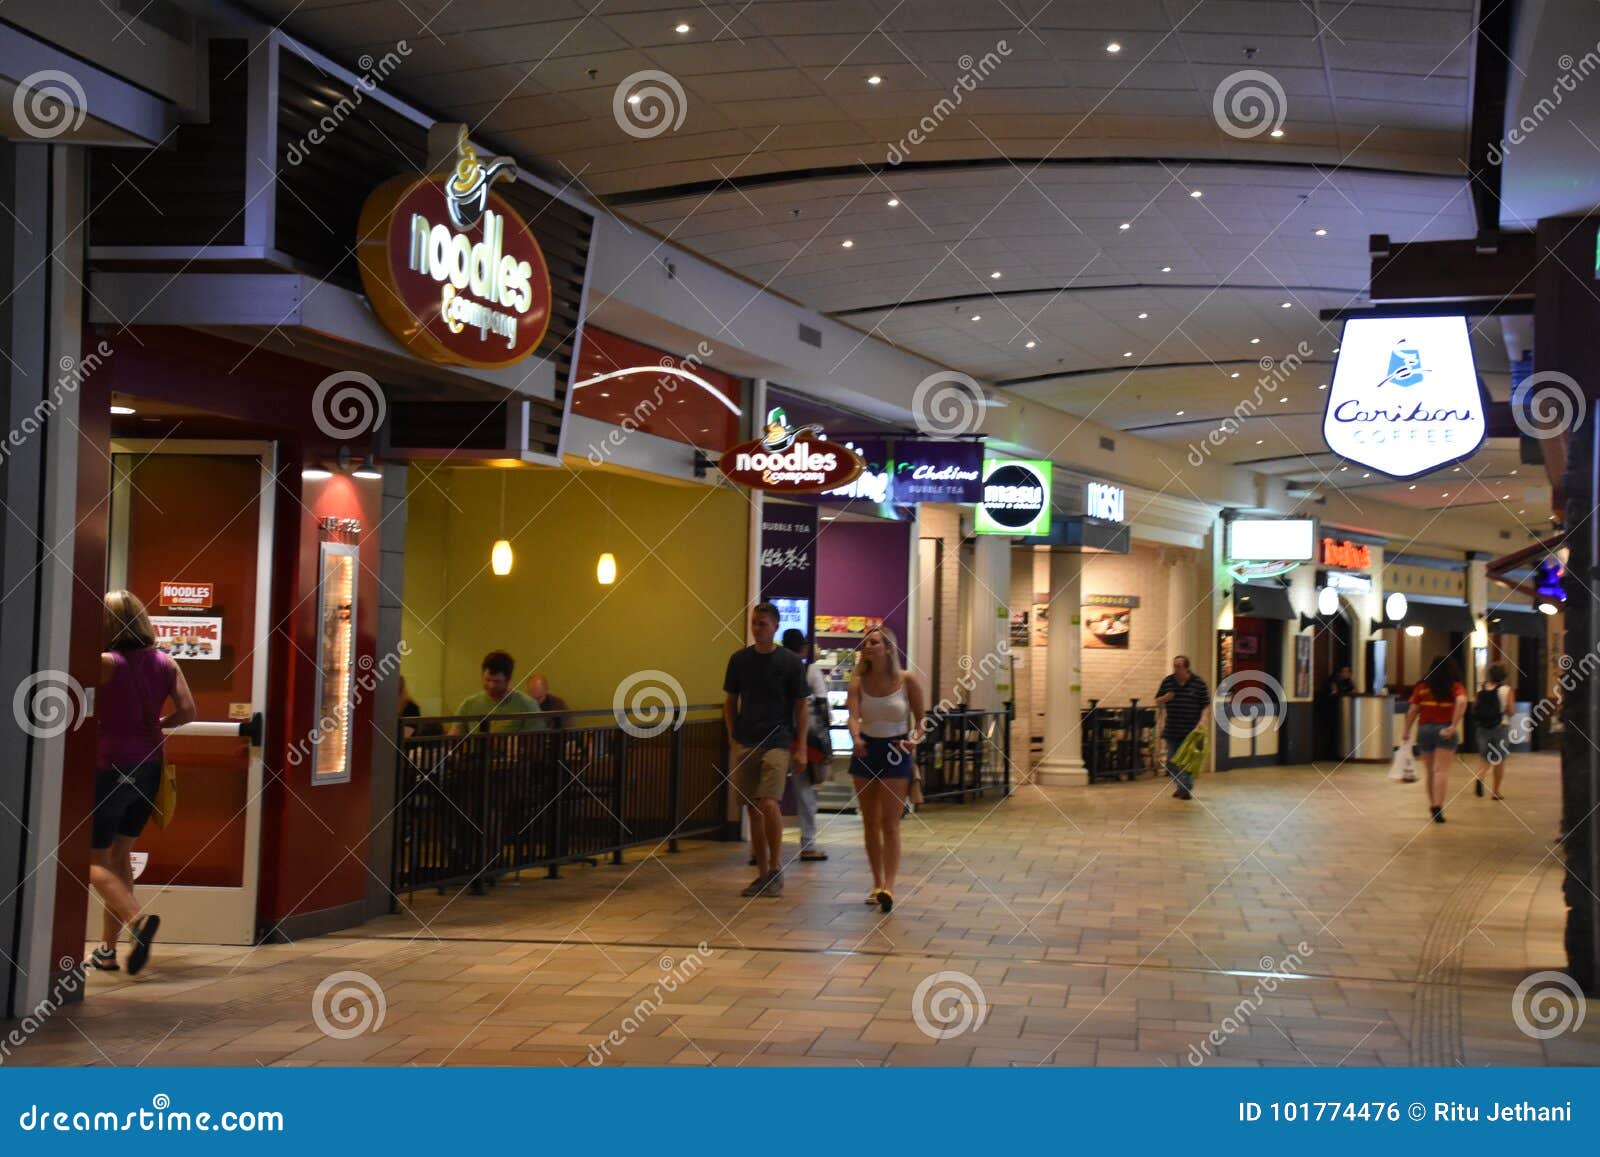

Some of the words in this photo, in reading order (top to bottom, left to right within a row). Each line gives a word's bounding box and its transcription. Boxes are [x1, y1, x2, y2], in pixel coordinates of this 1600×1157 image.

[409, 210, 532, 313] noodles
[1334, 400, 1471, 422] Caribou
[1353, 429, 1455, 444] COFFEE
[735, 442, 838, 471] noodles
[946, 486, 964, 494] TEA
[761, 522, 792, 532] BUBBLE
[795, 524, 810, 532] TEA
[163, 586, 209, 598] NOODLES
[153, 624, 217, 640] ATERING
